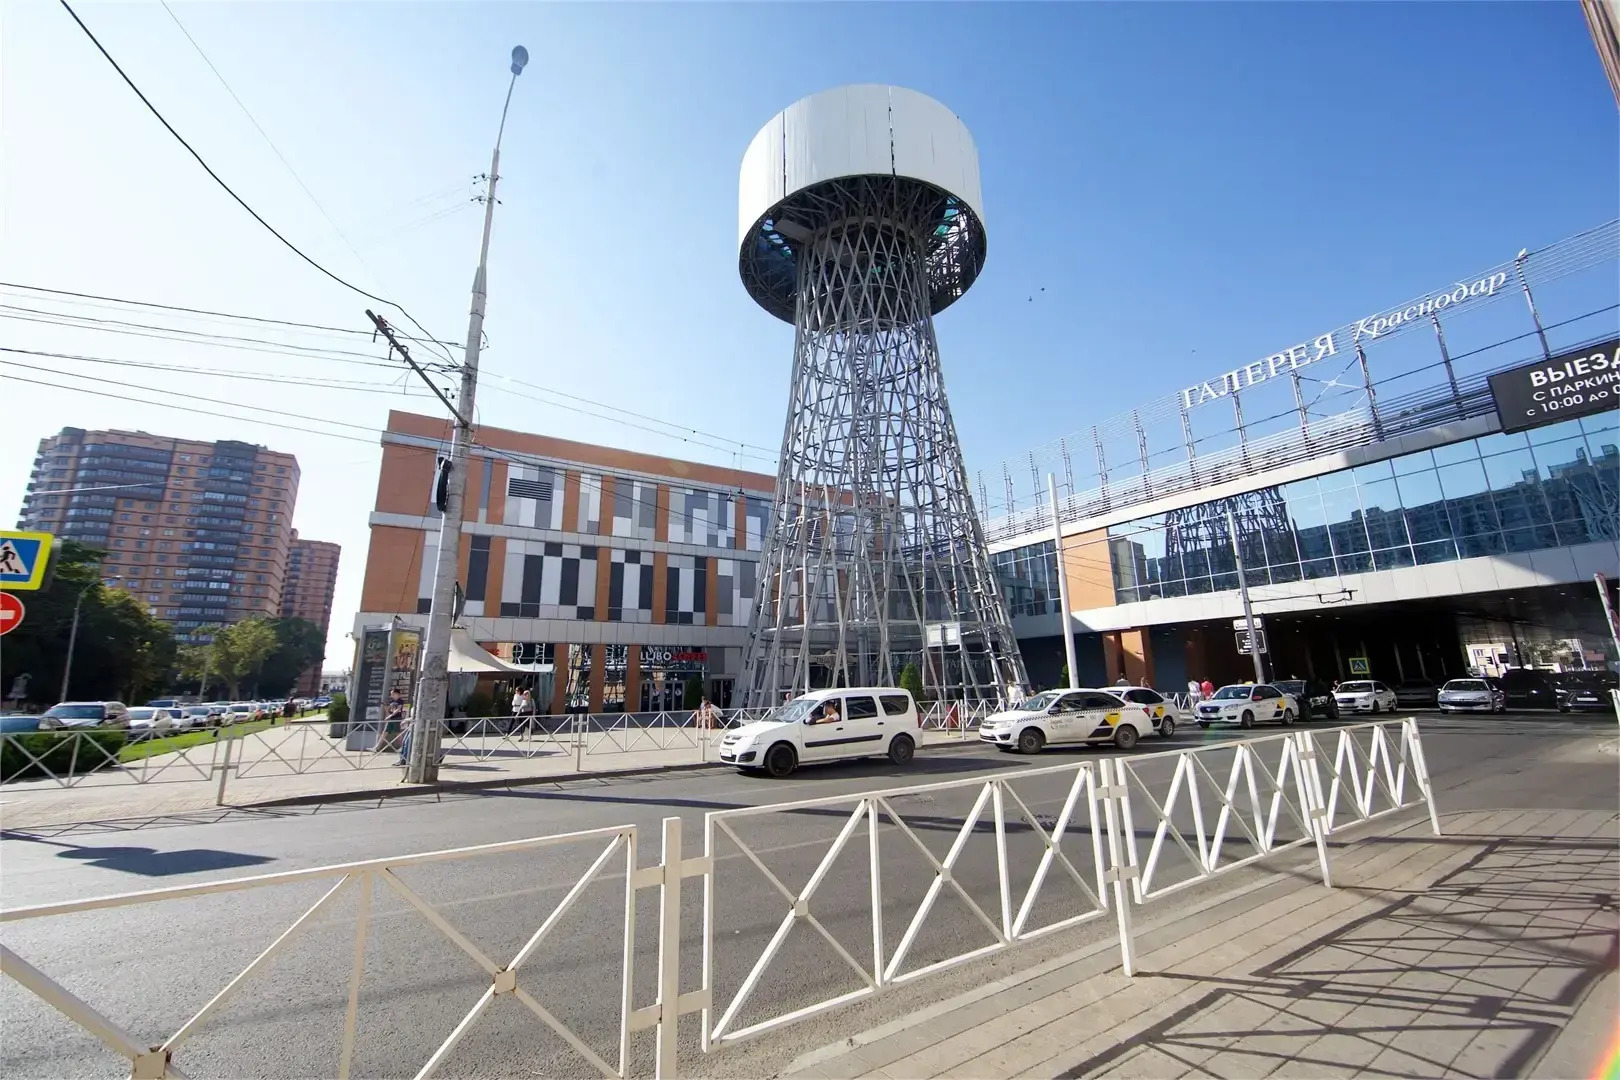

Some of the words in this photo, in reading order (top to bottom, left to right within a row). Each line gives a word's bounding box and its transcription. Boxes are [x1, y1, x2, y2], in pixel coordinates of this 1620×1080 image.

[1182, 332, 1340, 409] ГАЛЕРЕЯ
[1353, 271, 1506, 341] Краснодар
[1541, 394, 1584, 412] 10:00
